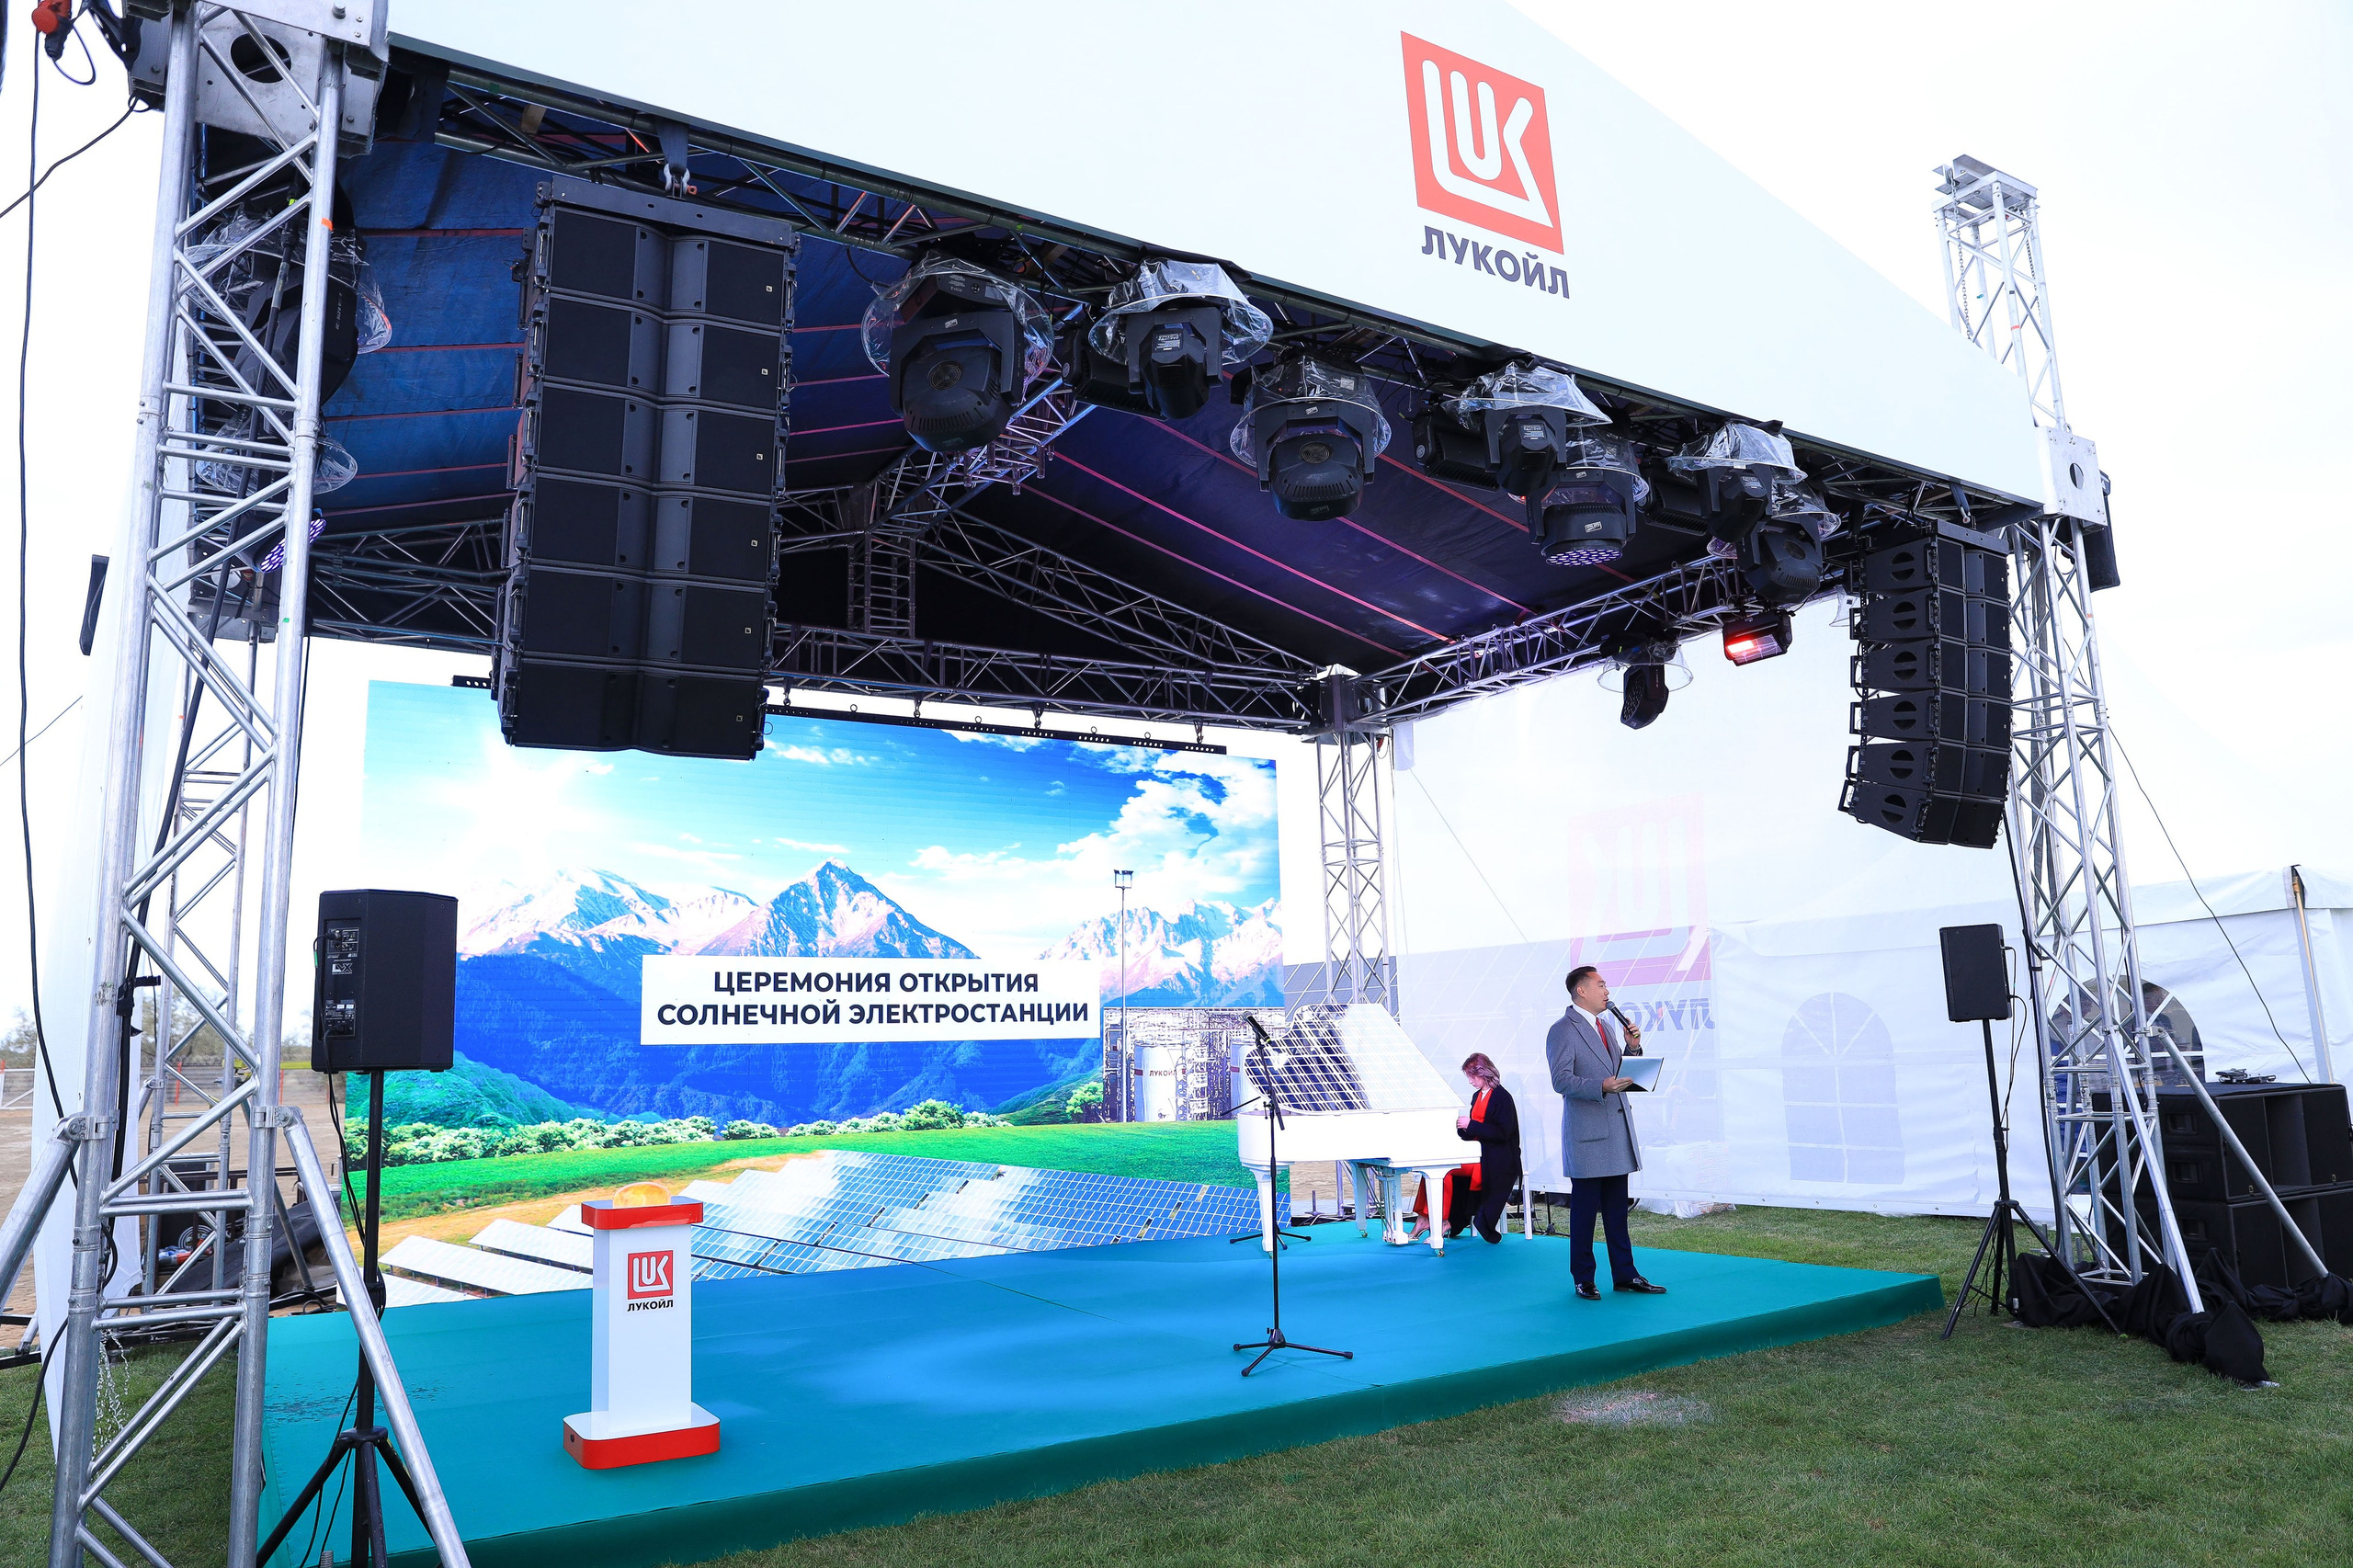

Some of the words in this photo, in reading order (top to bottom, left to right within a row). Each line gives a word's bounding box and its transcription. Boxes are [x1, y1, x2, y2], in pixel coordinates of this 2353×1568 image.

[1421, 224, 1570, 300] ЛУКОЙЛ
[713, 971, 891, 996] ЦЕРЕМОНИЯ
[899, 972, 1039, 994] ОТКРЫТИЯ
[657, 999, 841, 1026] СОЛНЕЧНОЙ
[848, 1002, 1089, 1025] ЭЛЕКТРОСТАНЦИИ
[627, 1298, 674, 1312] ЛУКОЙЛ
